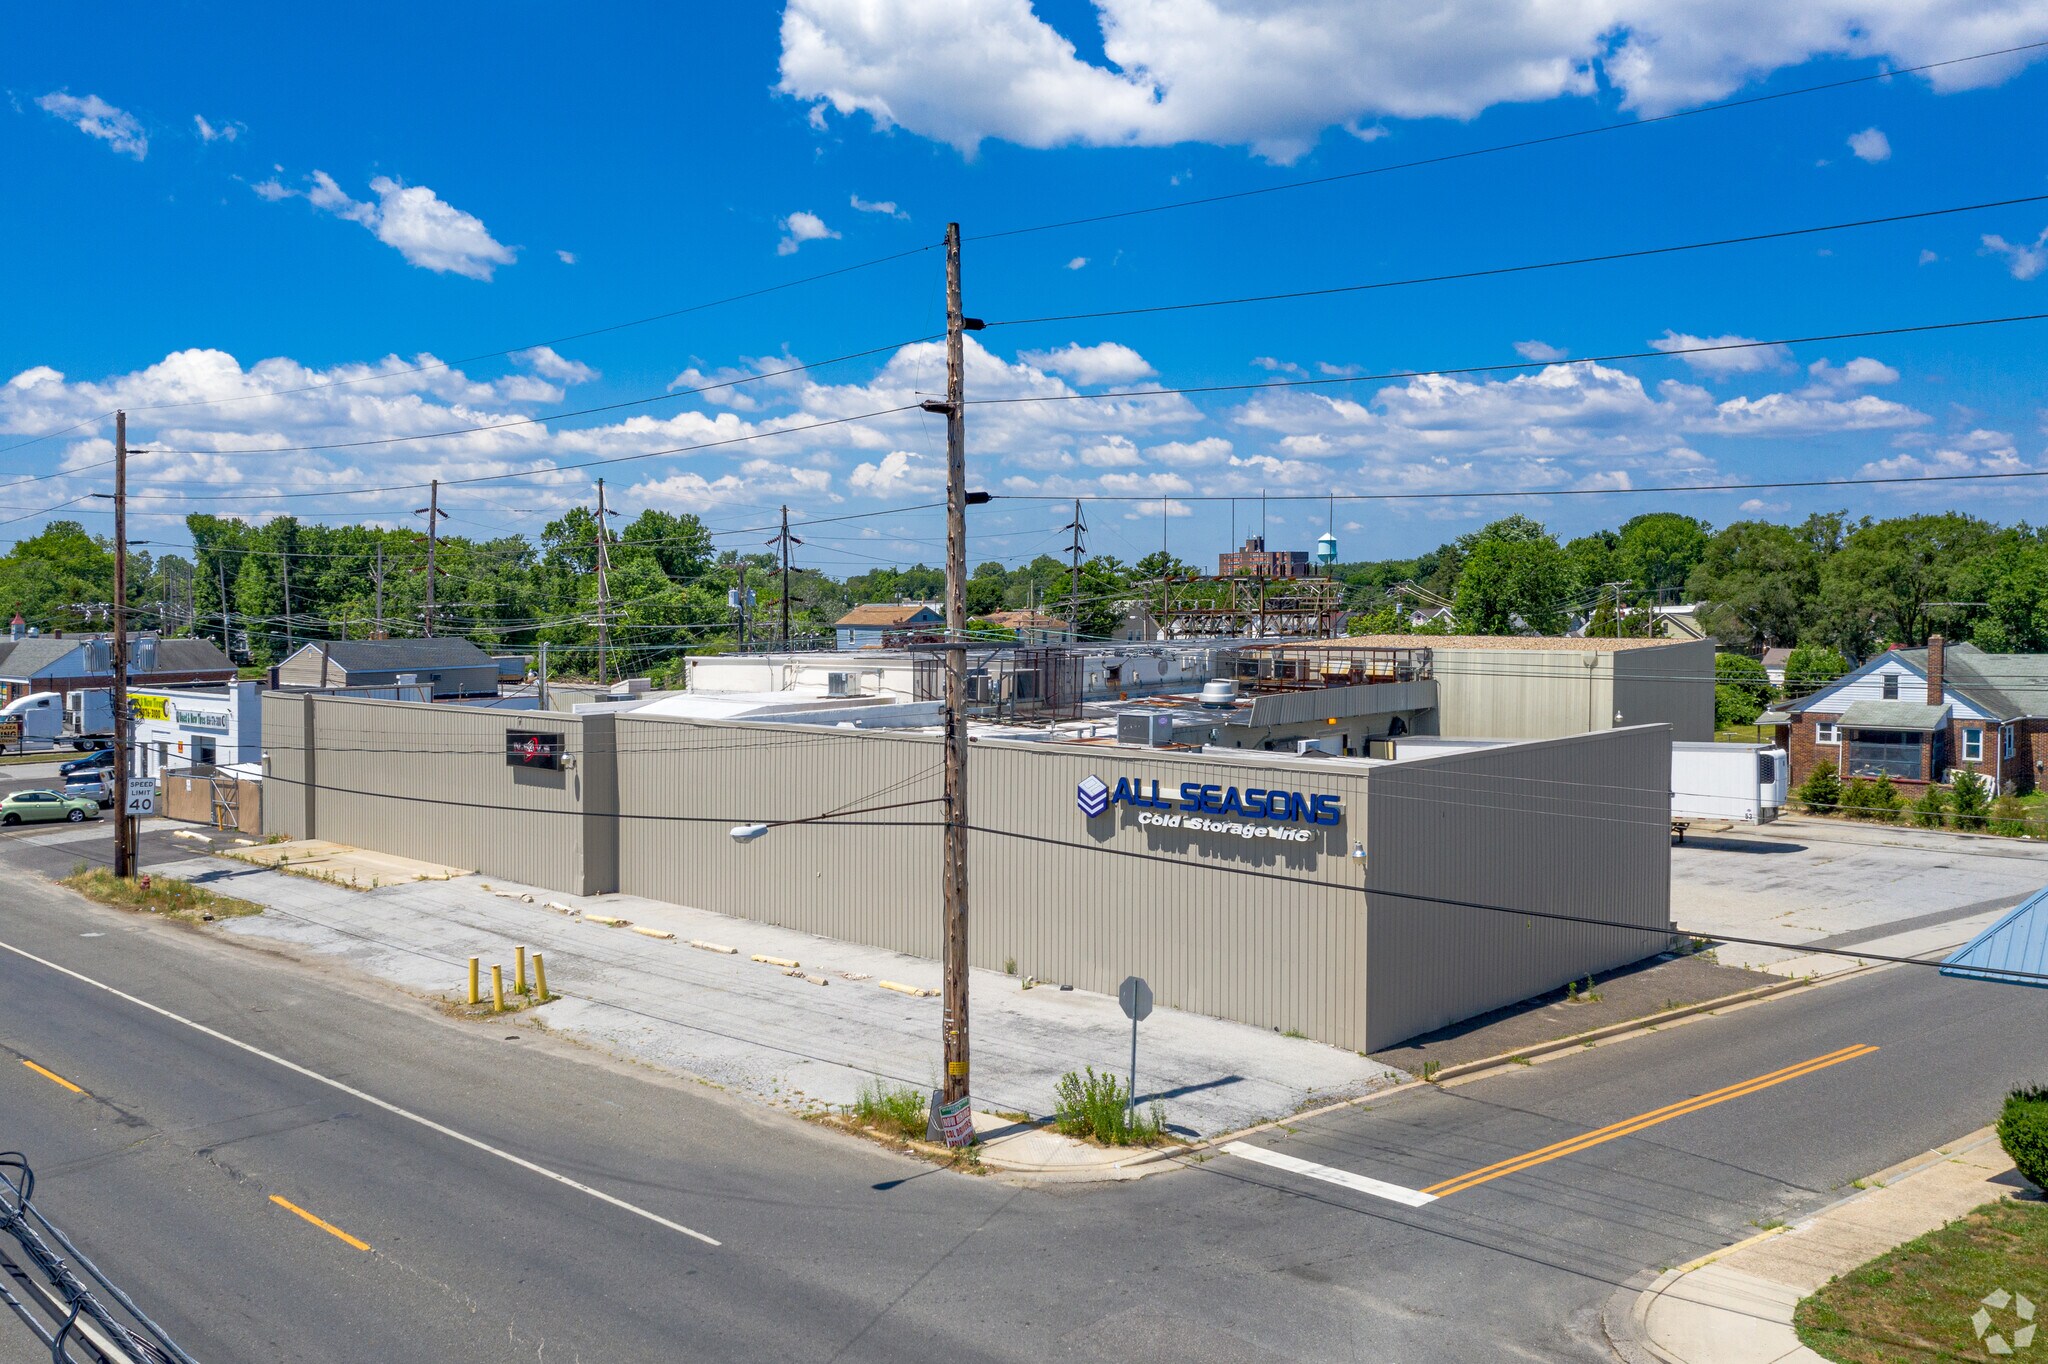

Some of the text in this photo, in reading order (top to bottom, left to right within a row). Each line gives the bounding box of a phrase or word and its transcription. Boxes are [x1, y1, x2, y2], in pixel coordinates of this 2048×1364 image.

[129, 798, 151, 810] 40
[1112, 777, 1340, 826] ALL SEASONS
[1138, 811, 1311, 842] Cold Storage Inc
